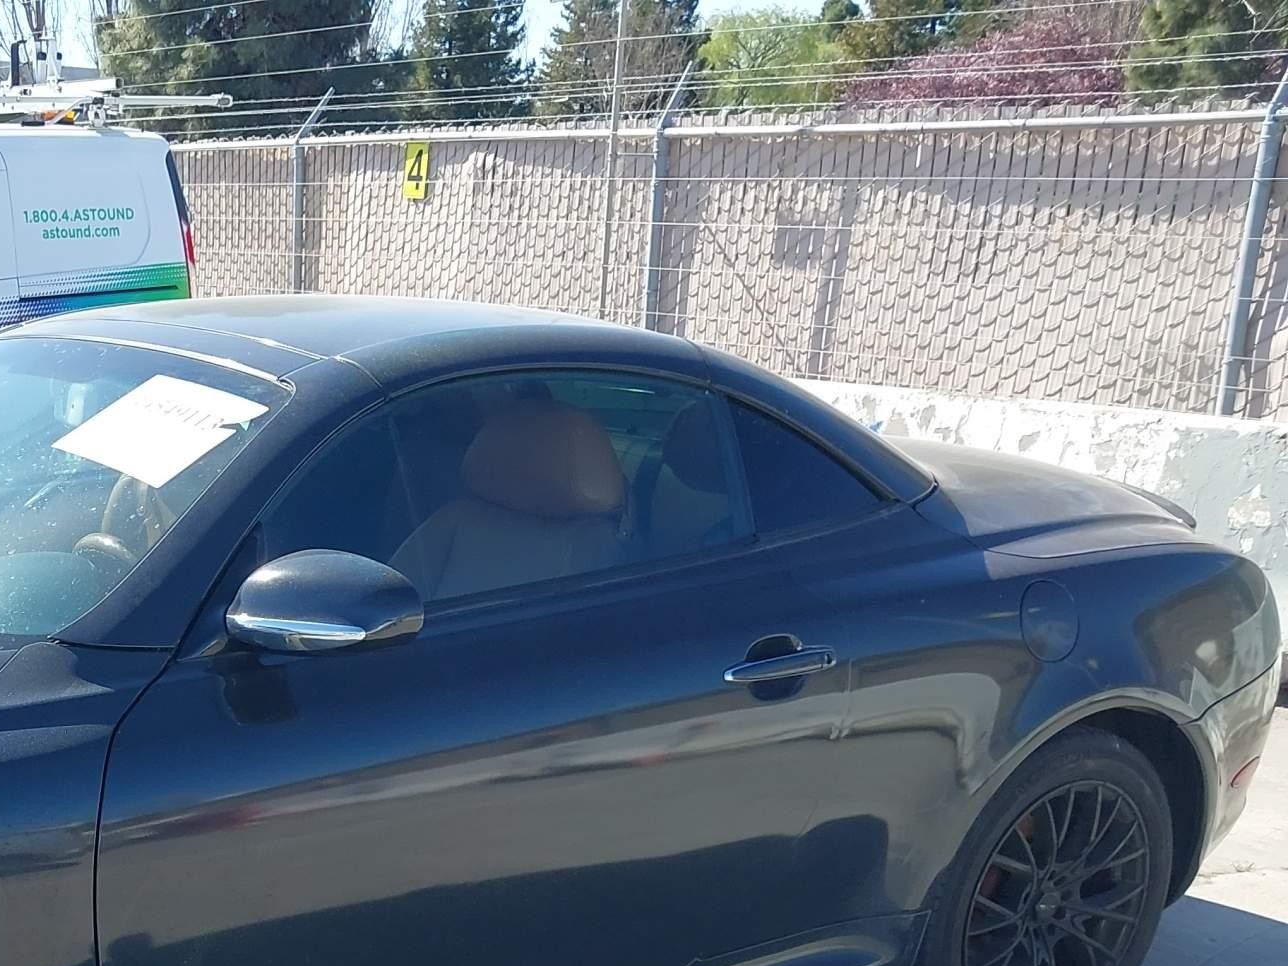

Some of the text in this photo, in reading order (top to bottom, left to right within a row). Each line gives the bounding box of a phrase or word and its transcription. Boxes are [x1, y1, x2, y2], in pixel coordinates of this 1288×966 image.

[407, 149, 424, 190] 4
[23, 207, 135, 223] 1.800.4.ASTOUND
[42, 224, 120, 239] astound.com
